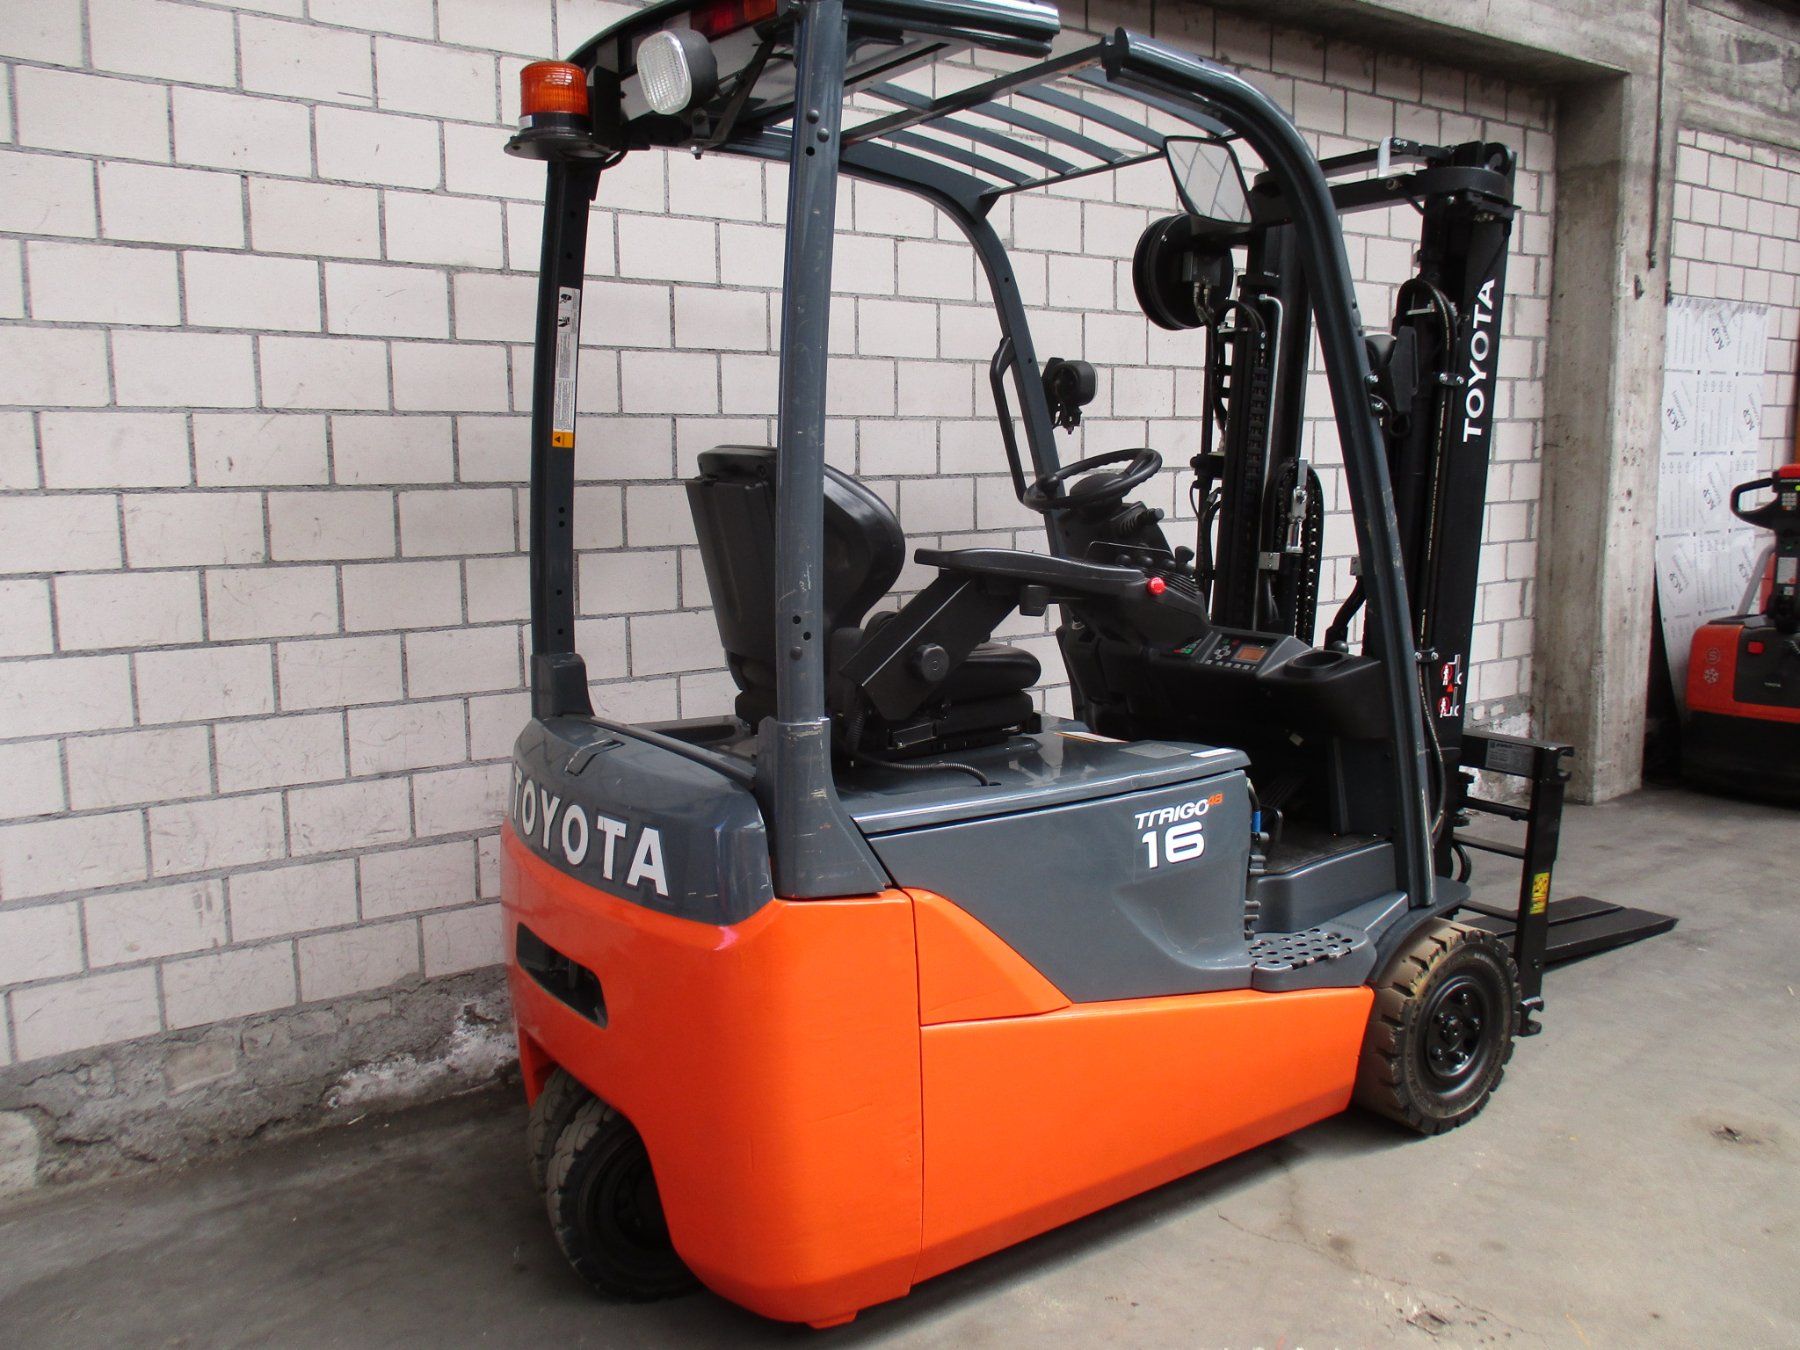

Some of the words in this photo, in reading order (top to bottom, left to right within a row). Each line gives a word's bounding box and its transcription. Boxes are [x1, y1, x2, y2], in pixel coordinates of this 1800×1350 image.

[1463, 279, 1495, 442] TOYOTA
[513, 765, 669, 897] TOYOTA
[1142, 820, 1205, 869] 16
